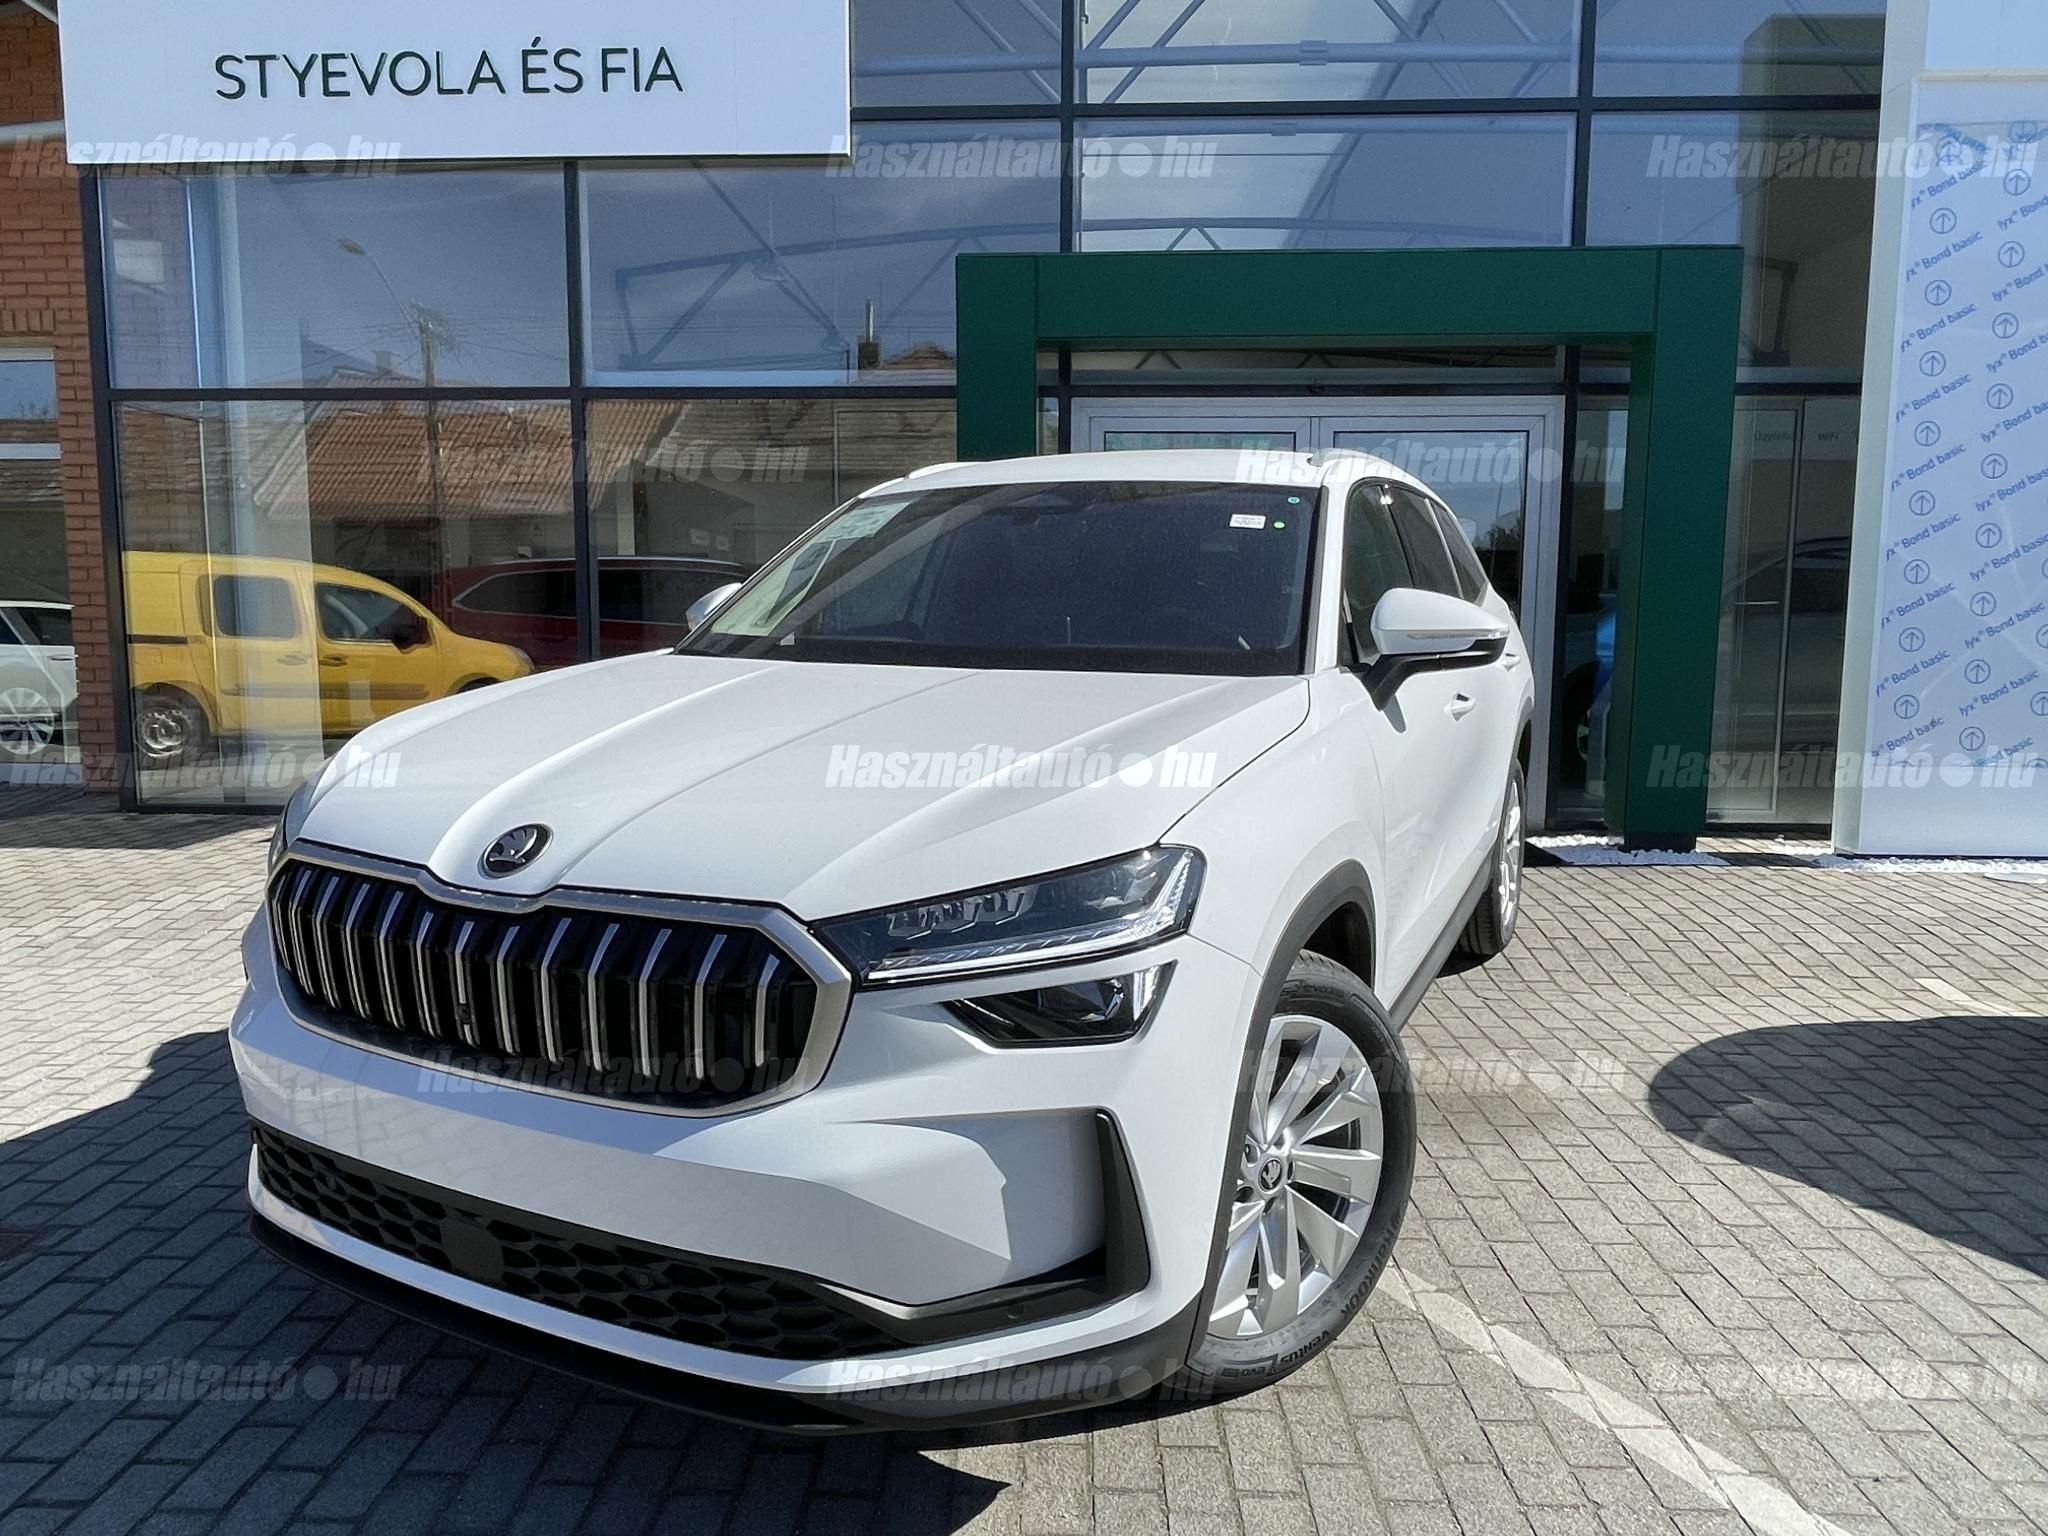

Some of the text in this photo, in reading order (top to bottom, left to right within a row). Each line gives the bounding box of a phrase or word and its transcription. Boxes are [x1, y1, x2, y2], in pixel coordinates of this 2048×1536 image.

[215, 36, 683, 100] STYEVOLA ÉS FIA
[1927, 175, 1957, 196] Bond
[1921, 245, 1951, 269] Bond
[1952, 231, 1983, 252] basic
[2014, 267, 2044, 288] Bond
[1916, 318, 1946, 340] Bond
[1946, 303, 1977, 324] basic
[2008, 338, 2038, 360] Bond
[1911, 388, 1941, 410] Bond
[1941, 374, 1972, 394] basic
[2002, 409, 2032, 430] Bond
[1906, 458, 1936, 480] Bond
[1936, 443, 1966, 464] basic
[1997, 479, 2026, 500] Bond
[1901, 528, 1930, 549] Bond
[1930, 513, 1961, 533] basic
[1991, 548, 2021, 569] Bond
[1896, 596, 1925, 617] Bond
[1925, 582, 1956, 602] basic
[1986, 616, 2015, 637] Bond
[2016, 602, 2046, 622] basic
[1891, 664, 1920, 685] Bond
[1920, 649, 1951, 670] basic
[1980, 684, 2009, 704] Bond
[2010, 670, 2040, 690] basic
[1886, 731, 1914, 751] Bond
[1915, 716, 1945, 737] basic
